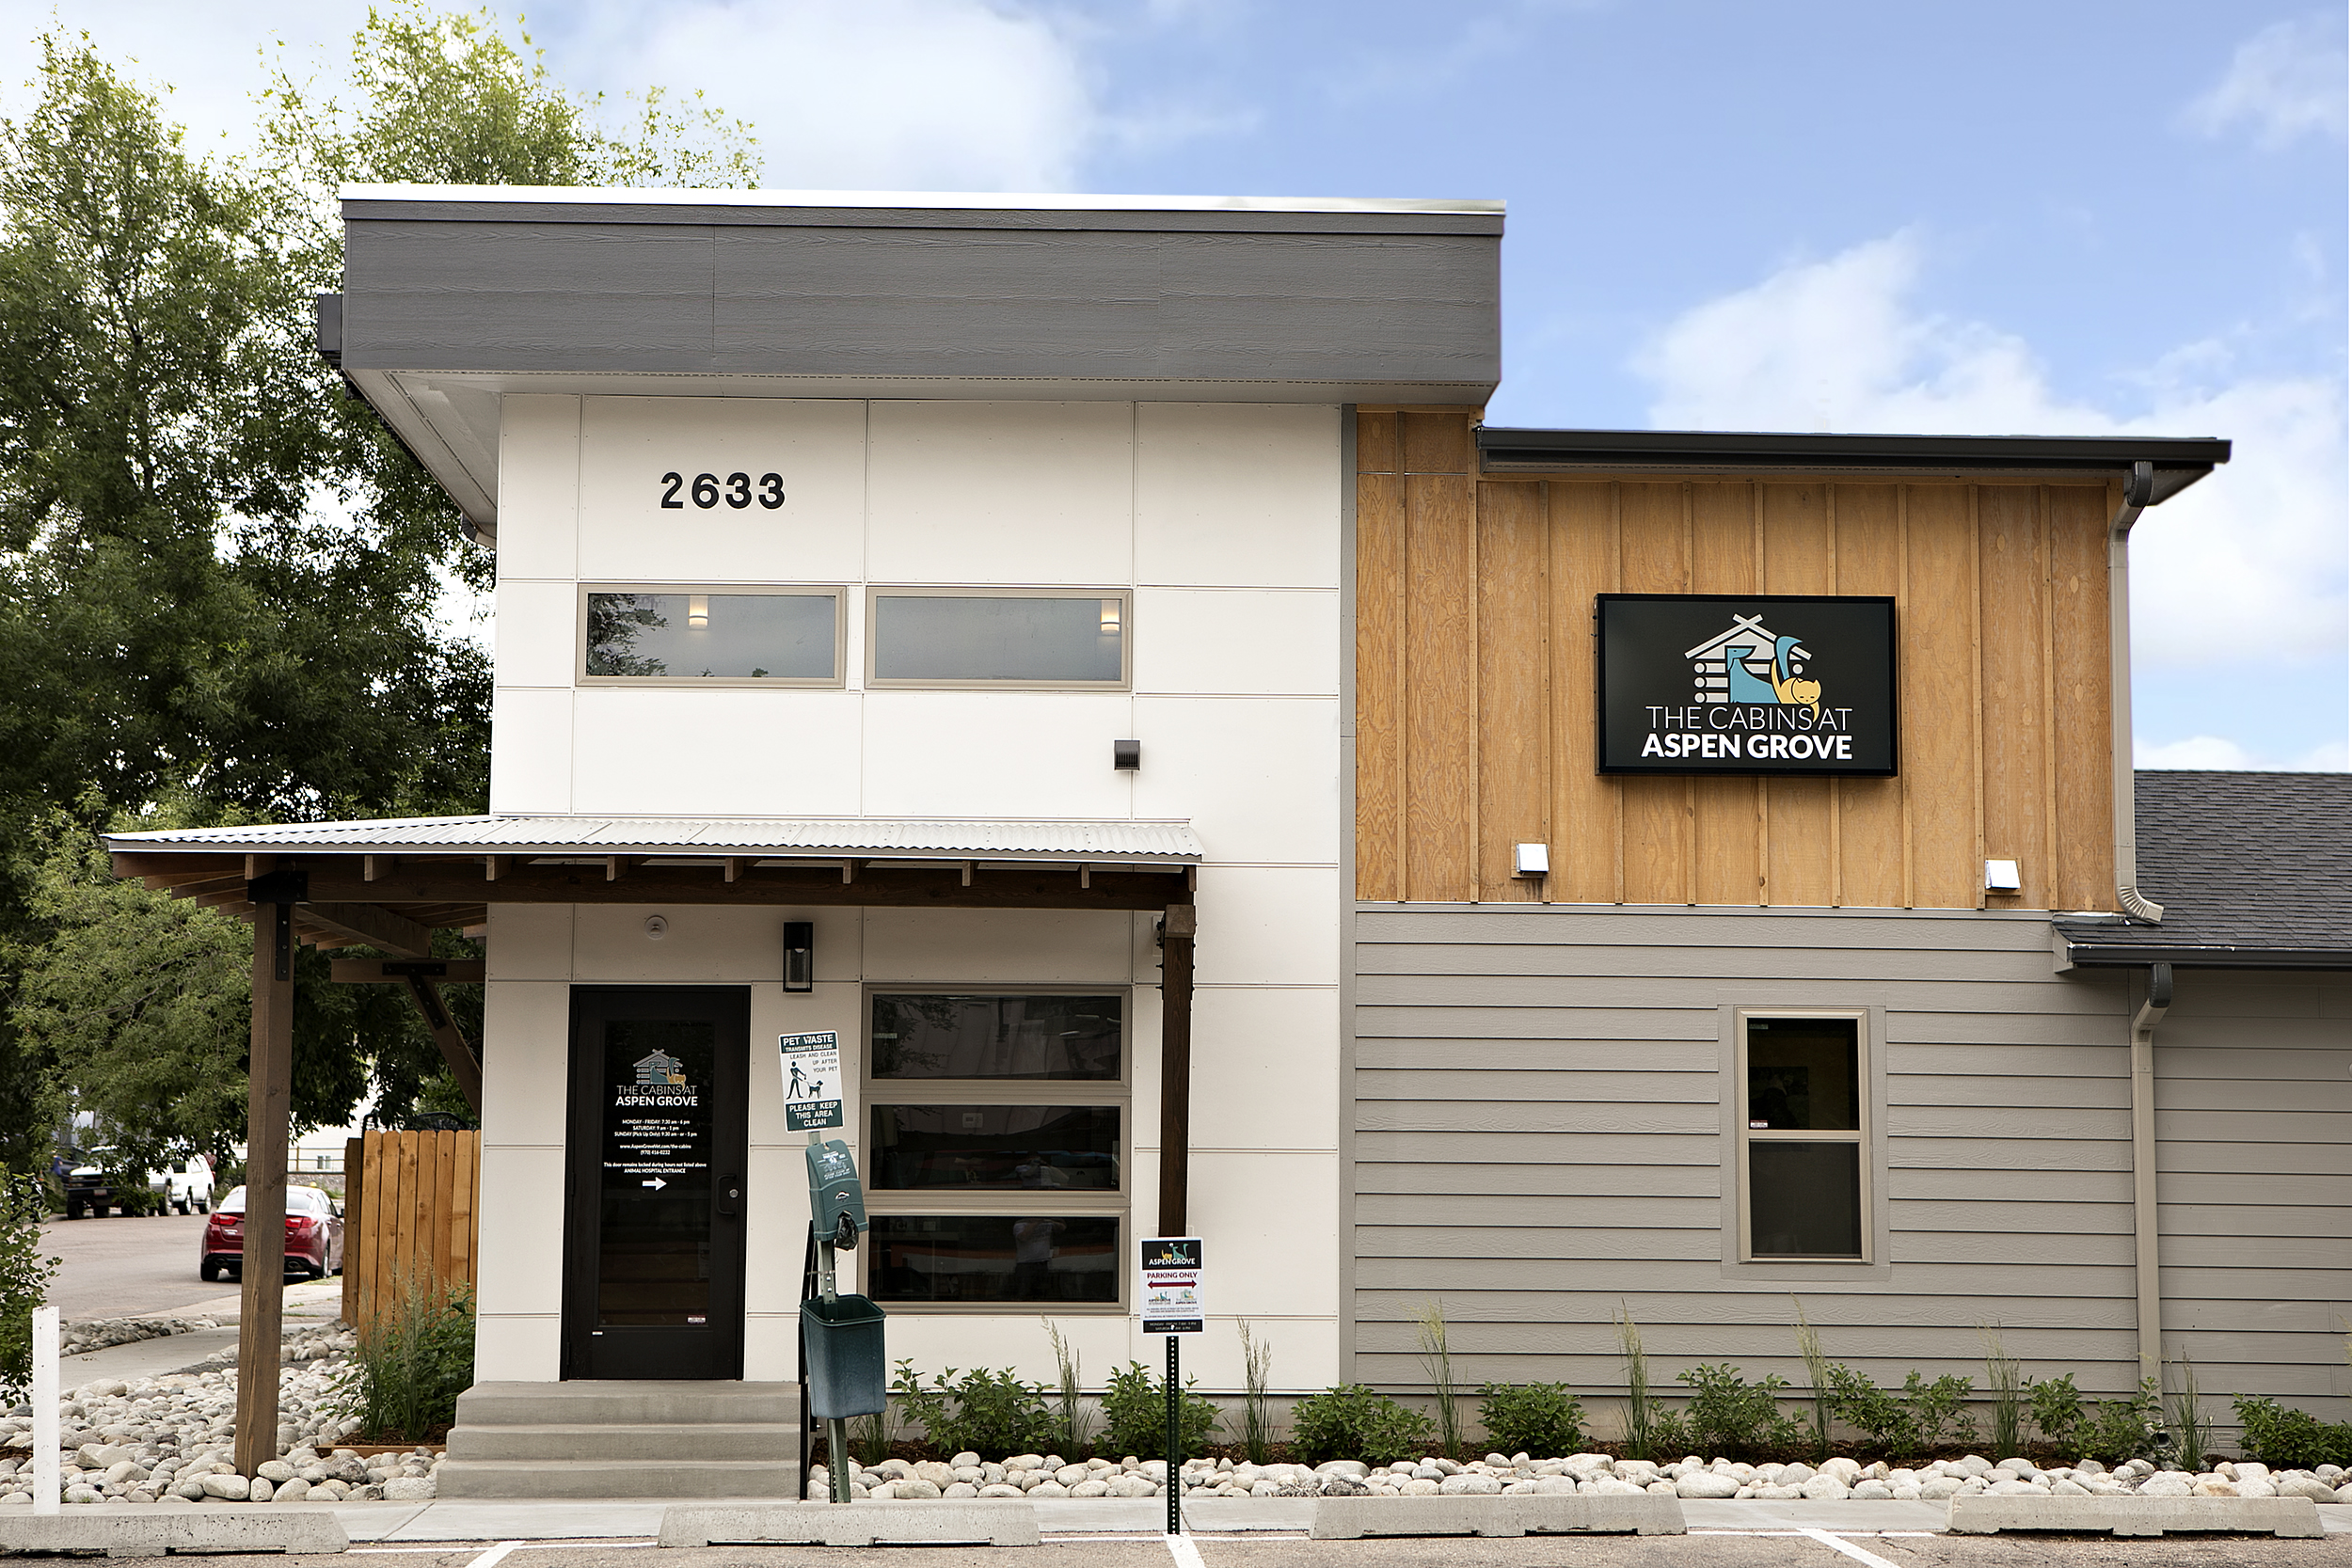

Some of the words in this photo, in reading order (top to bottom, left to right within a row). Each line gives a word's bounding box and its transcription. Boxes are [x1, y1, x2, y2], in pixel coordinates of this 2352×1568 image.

[660, 471, 786, 510] 2633
[1645, 706, 1702, 730] THE
[1708, 706, 1813, 731] CABINS
[1817, 708, 1853, 731] AT
[1641, 733, 1740, 758] ASPEN
[1747, 734, 1853, 760] GROVE
[783, 1037, 801, 1047] PET
[803, 1034, 834, 1045] WASTE
[616, 1085, 639, 1096] THE
[641, 1085, 682, 1096] CABINS
[682, 1085, 698, 1096] AT
[615, 1096, 655, 1106] ASPEN
[657, 1096, 698, 1106] GROVE
[788, 1102, 817, 1113] PLEASE
[819, 1101, 838, 1110] KEEP
[795, 1112, 812, 1120] THIS
[814, 1110, 834, 1118] AREA
[803, 1117, 827, 1127] CLEAN
